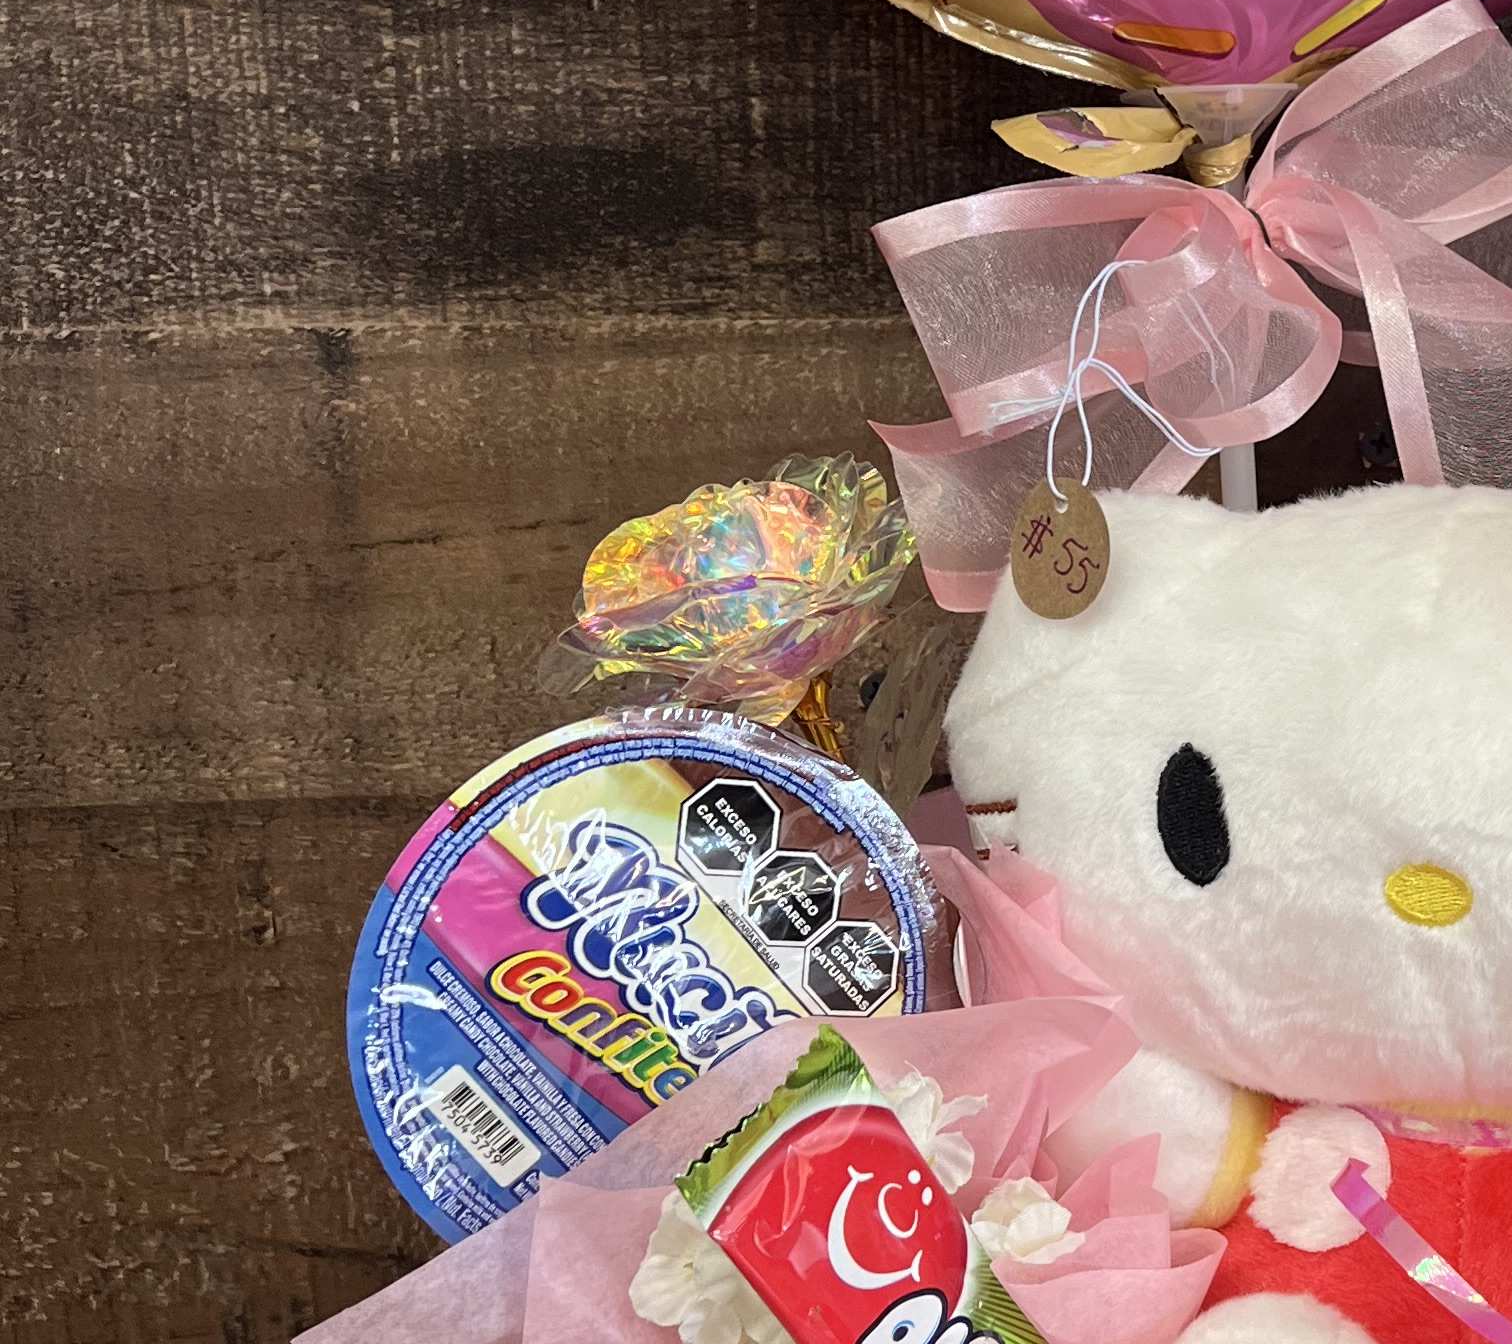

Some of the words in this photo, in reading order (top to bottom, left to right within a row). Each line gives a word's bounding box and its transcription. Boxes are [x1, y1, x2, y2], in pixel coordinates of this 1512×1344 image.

[713, 794, 758, 848] EXCESO
[775, 866, 820, 919] EXCESO
[751, 938, 763, 949] DE
[759, 947, 781, 970] SALUD
[809, 943, 870, 1013] SATURADAS
[841, 933, 884, 982] EXCESO
[428, 959, 456, 987] DULCE
[474, 1010, 502, 1038] SABOR
[530, 1070, 564, 1106] VAINILLA
[559, 1101, 586, 1130] FRESA
[576, 1121, 596, 1142] CON
[490, 950, 698, 1102] Confite
[434, 990, 467, 1024] CREAMY
[457, 1015, 485, 1044] CANDY
[510, 1071, 542, 1105] VANILLA
[533, 1096, 553, 1117] AND
[544, 1108, 588, 1157] STRAWBERRY
[475, 1058, 499, 1082] WITH
[490, 1073, 530, 1117] CHOCOLATE
[521, 1107, 558, 1148] FLAVORED
[440, 1100, 472, 1136] 7504
[469, 1131, 503, 1168] 5739
[455, 1207, 484, 1235] Facts
